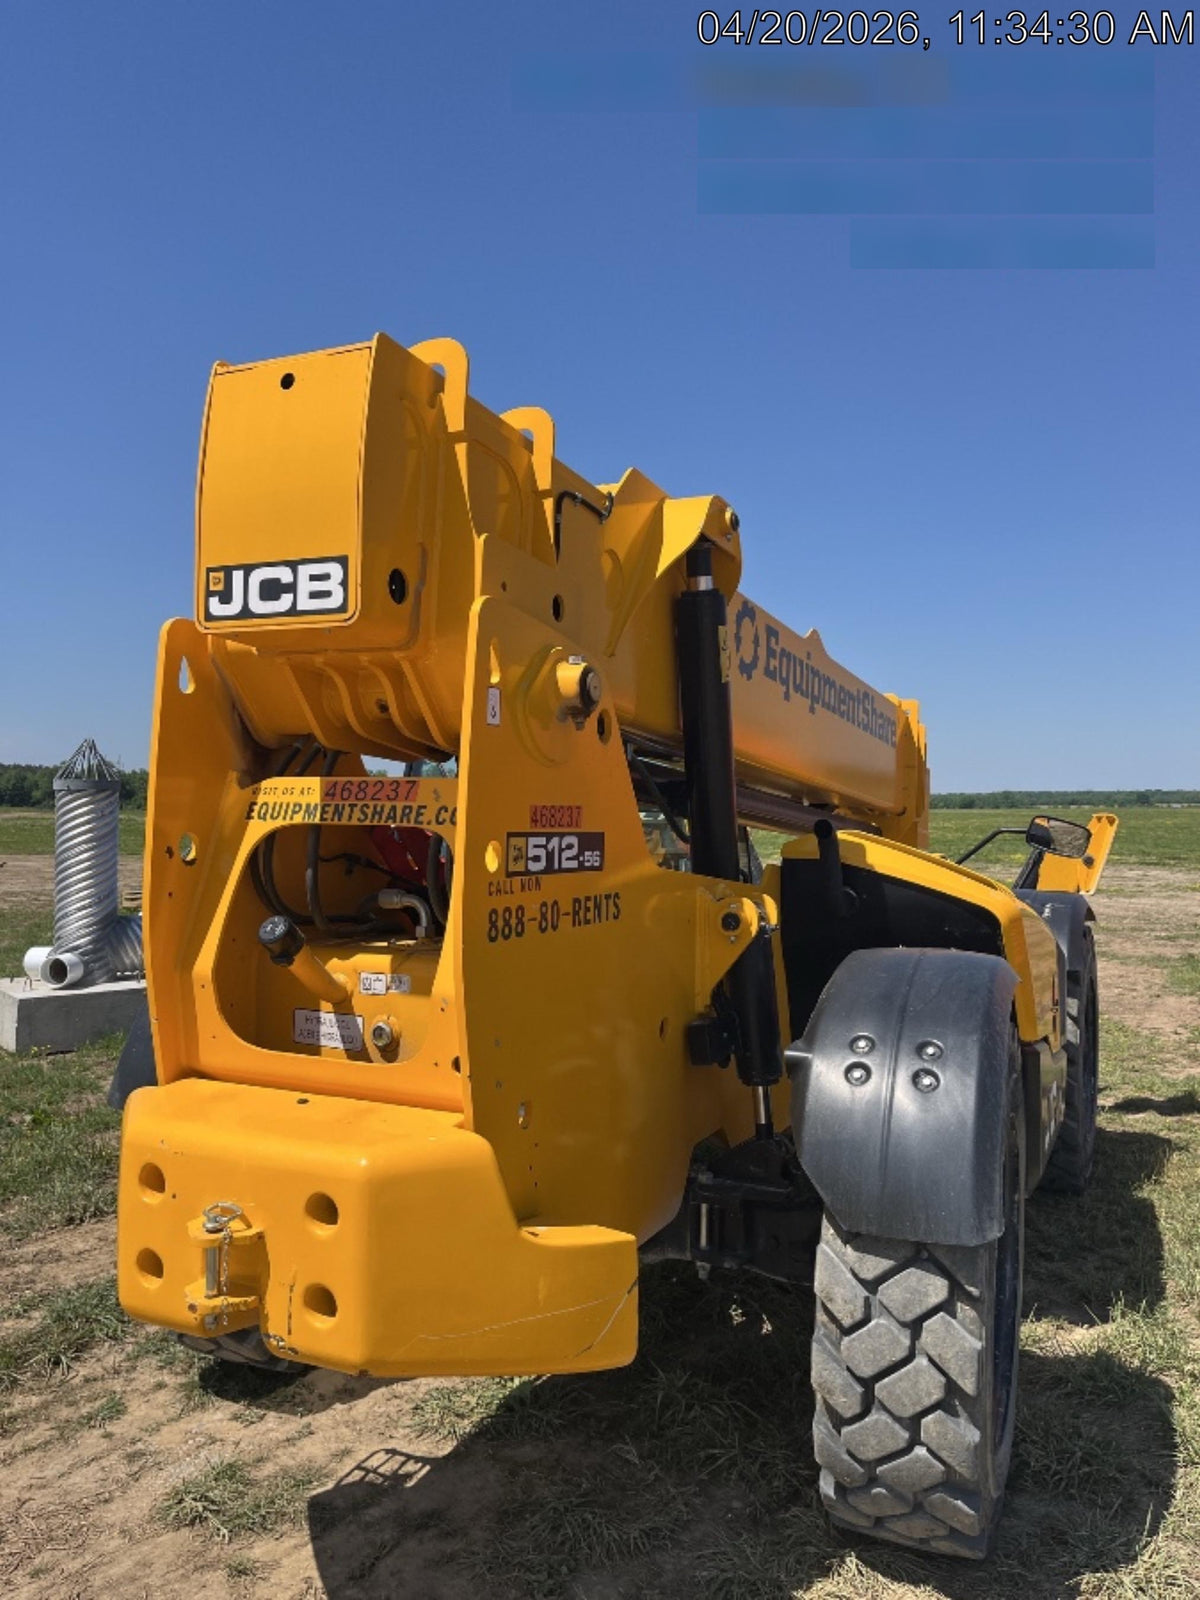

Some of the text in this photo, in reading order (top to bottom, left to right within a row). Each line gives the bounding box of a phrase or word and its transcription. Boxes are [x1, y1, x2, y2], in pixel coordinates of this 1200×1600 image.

[208, 561, 344, 616] JCB
[763, 623, 897, 748] EquipmentShare
[324, 780, 417, 801] 468237
[531, 805, 582, 828] 468237
[488, 880, 515, 897] CALL
[487, 892, 621, 943] 888-80-RENTS
